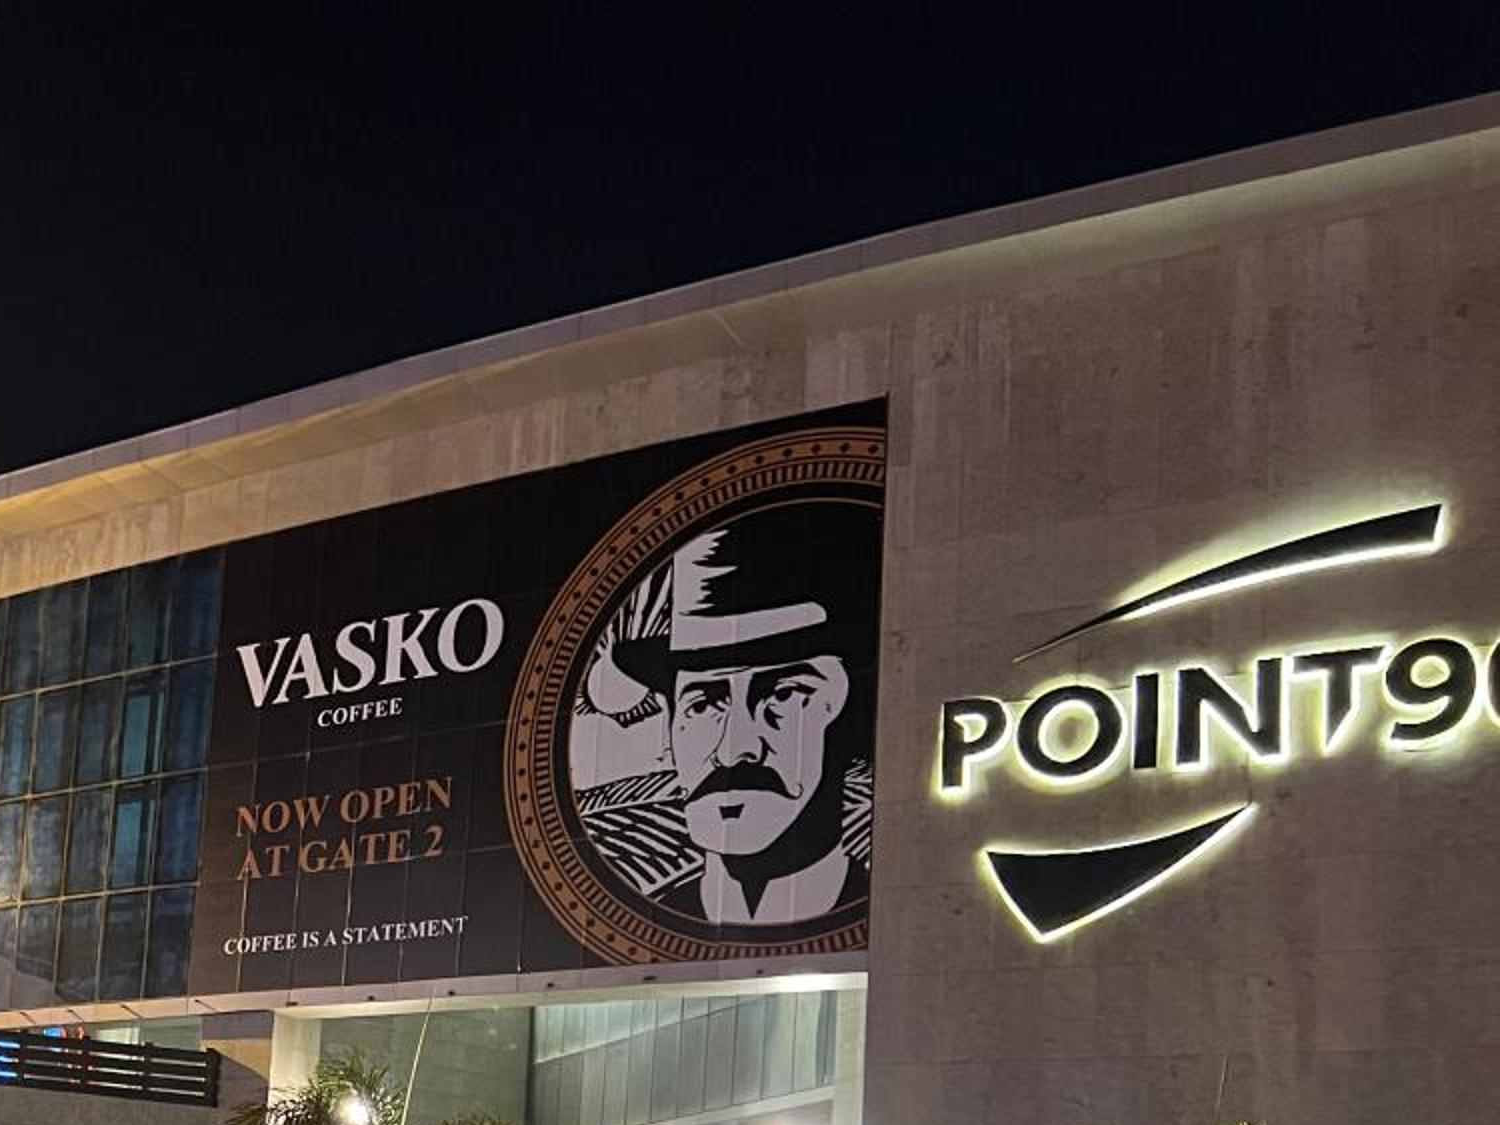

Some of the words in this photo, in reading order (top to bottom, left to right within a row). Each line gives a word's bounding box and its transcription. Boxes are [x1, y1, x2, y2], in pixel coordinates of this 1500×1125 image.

[236, 598, 505, 708] VASKO
[317, 698, 402, 727] COFFEE
[941, 637, 1500, 790] POINT9
[236, 795, 329, 837] NOW
[340, 777, 452, 823] OPEN
[236, 845, 289, 881] AT
[300, 829, 411, 873] GATE
[424, 825, 443, 857] 2
[224, 933, 297, 954] COFFEE
[302, 931, 319, 948] IS
[324, 931, 337, 947] A
[342, 916, 468, 945] STATEMENT
